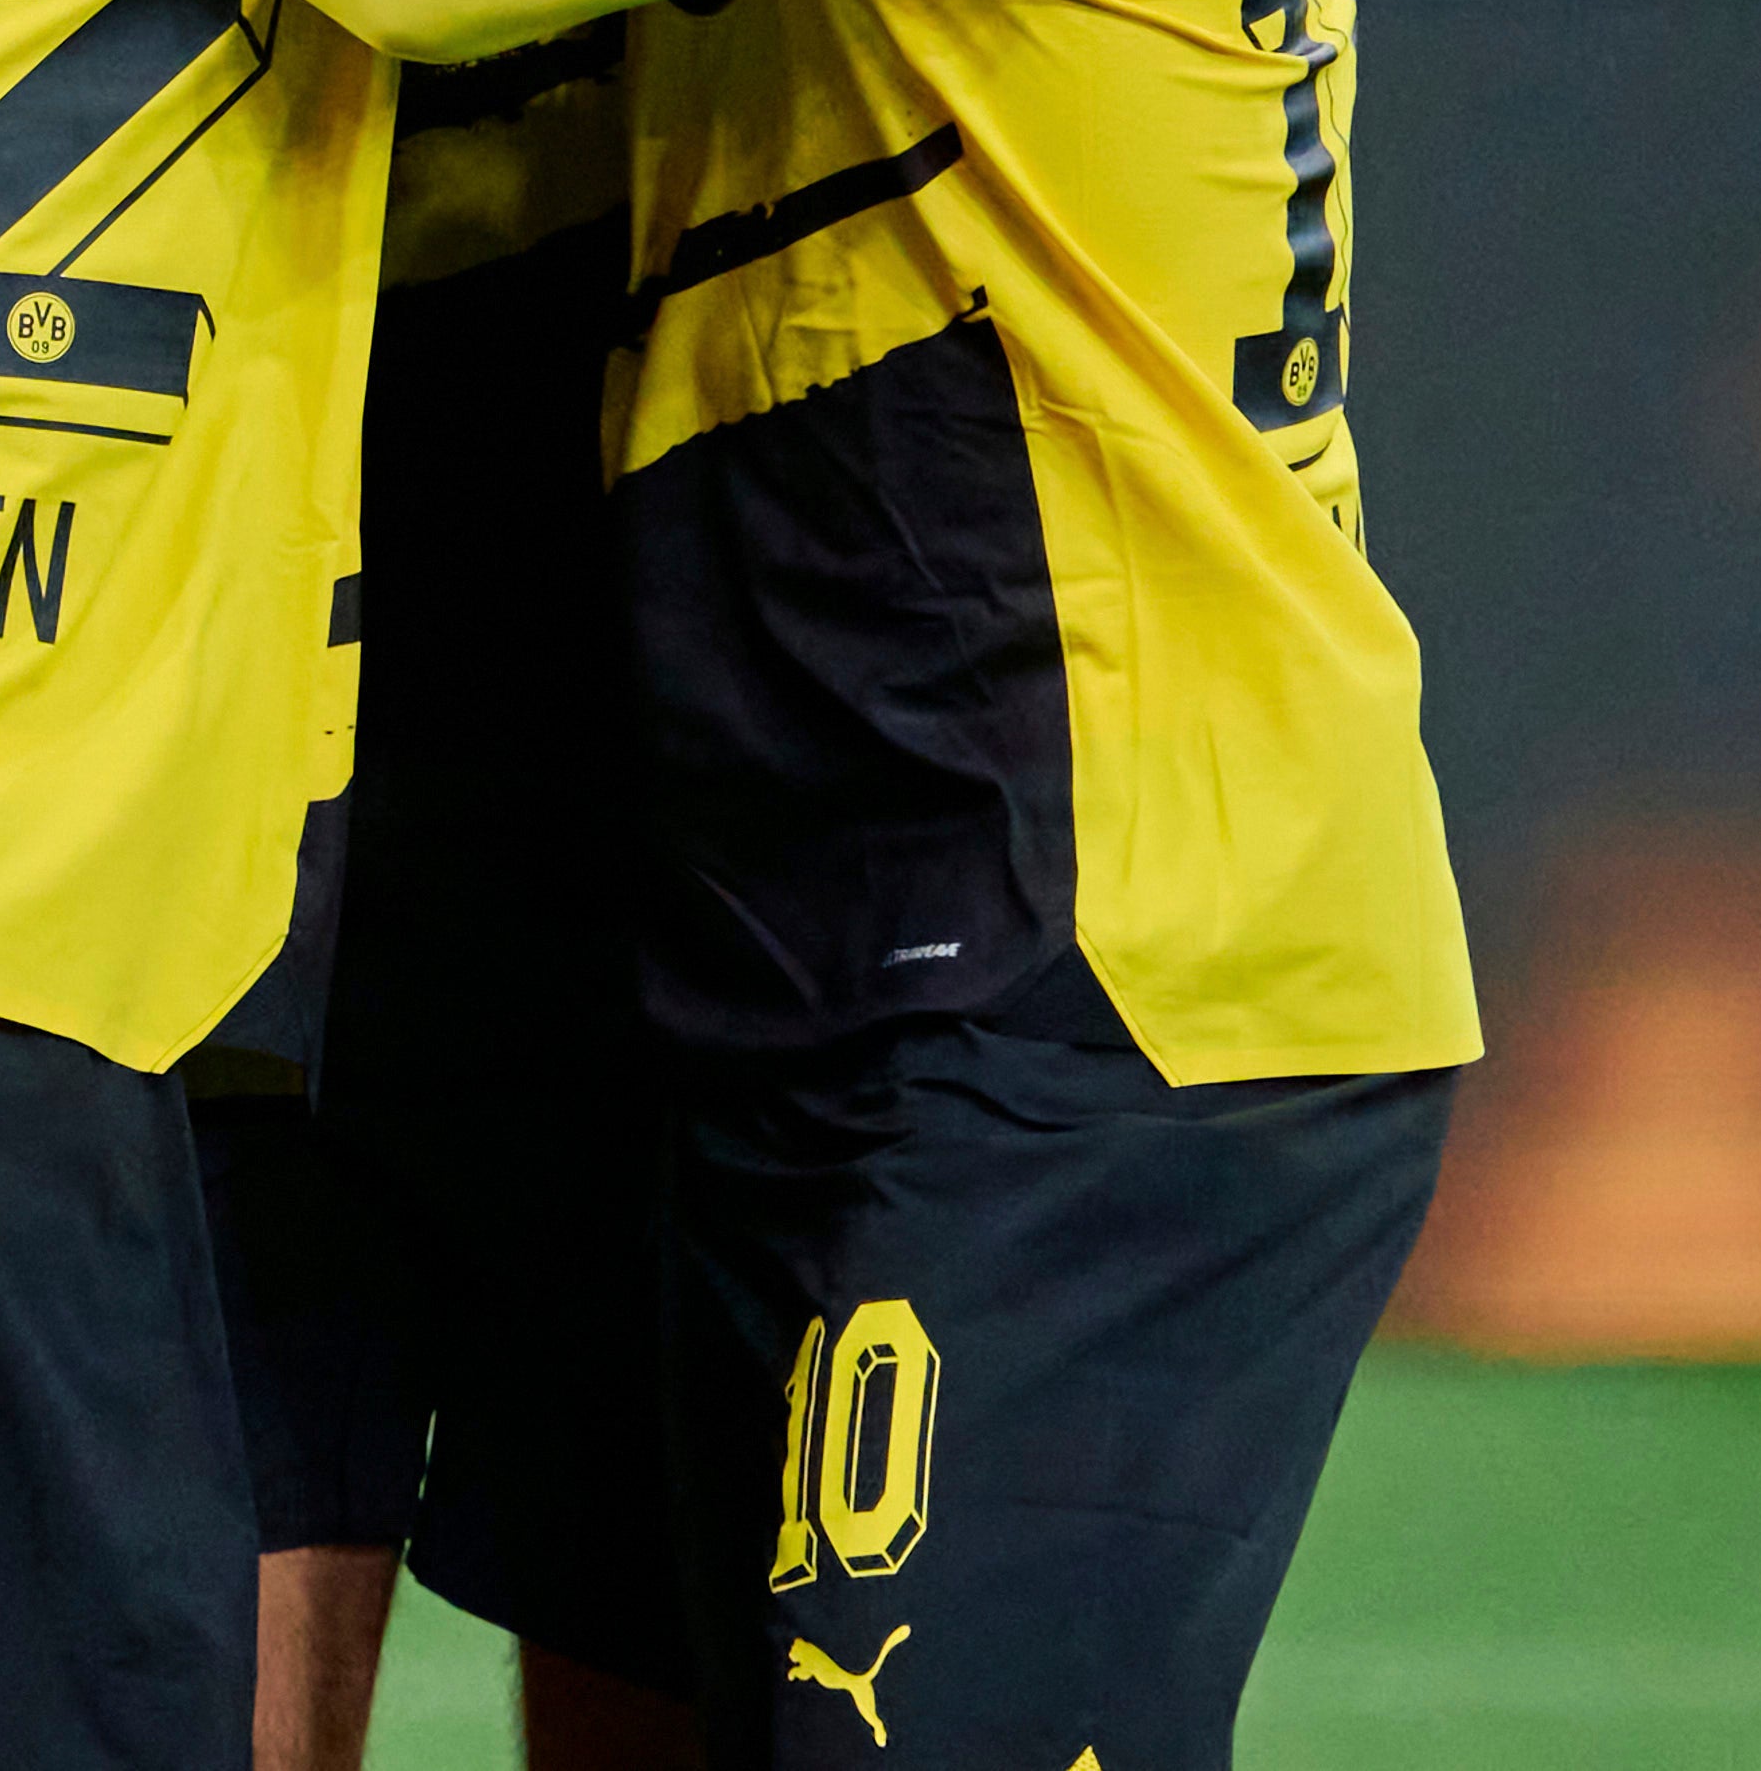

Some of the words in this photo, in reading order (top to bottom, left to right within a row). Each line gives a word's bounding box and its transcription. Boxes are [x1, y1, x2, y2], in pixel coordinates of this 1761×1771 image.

[18, 300, 67, 341] BVB
[32, 340, 50, 355] 09
[769, 1298, 941, 1594] 10
